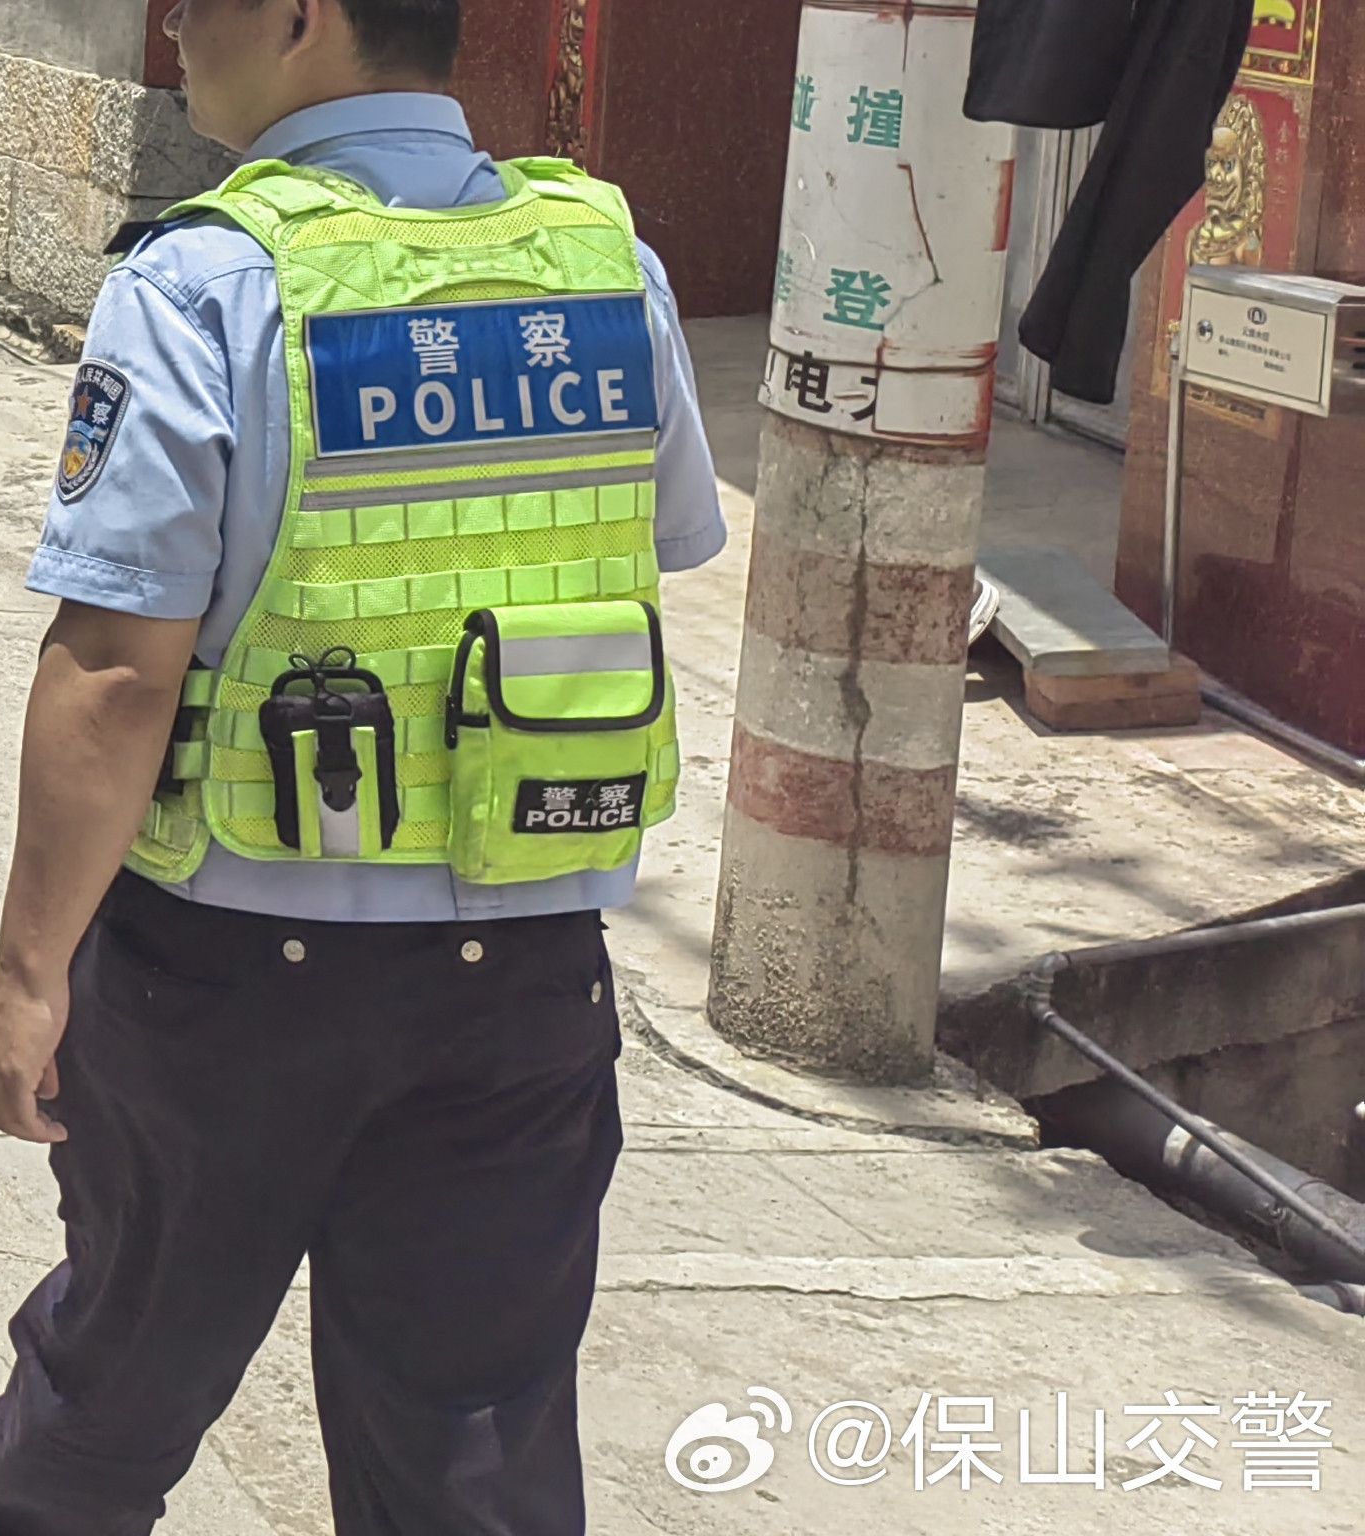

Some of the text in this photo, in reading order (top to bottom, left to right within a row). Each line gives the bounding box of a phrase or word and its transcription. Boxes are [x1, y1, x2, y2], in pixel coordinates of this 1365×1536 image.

[407, 311, 571, 376] 警察
[359, 369, 628, 441] POLICE
[525, 804, 635, 827] POLICE
[542, 784, 631, 810] 警察
